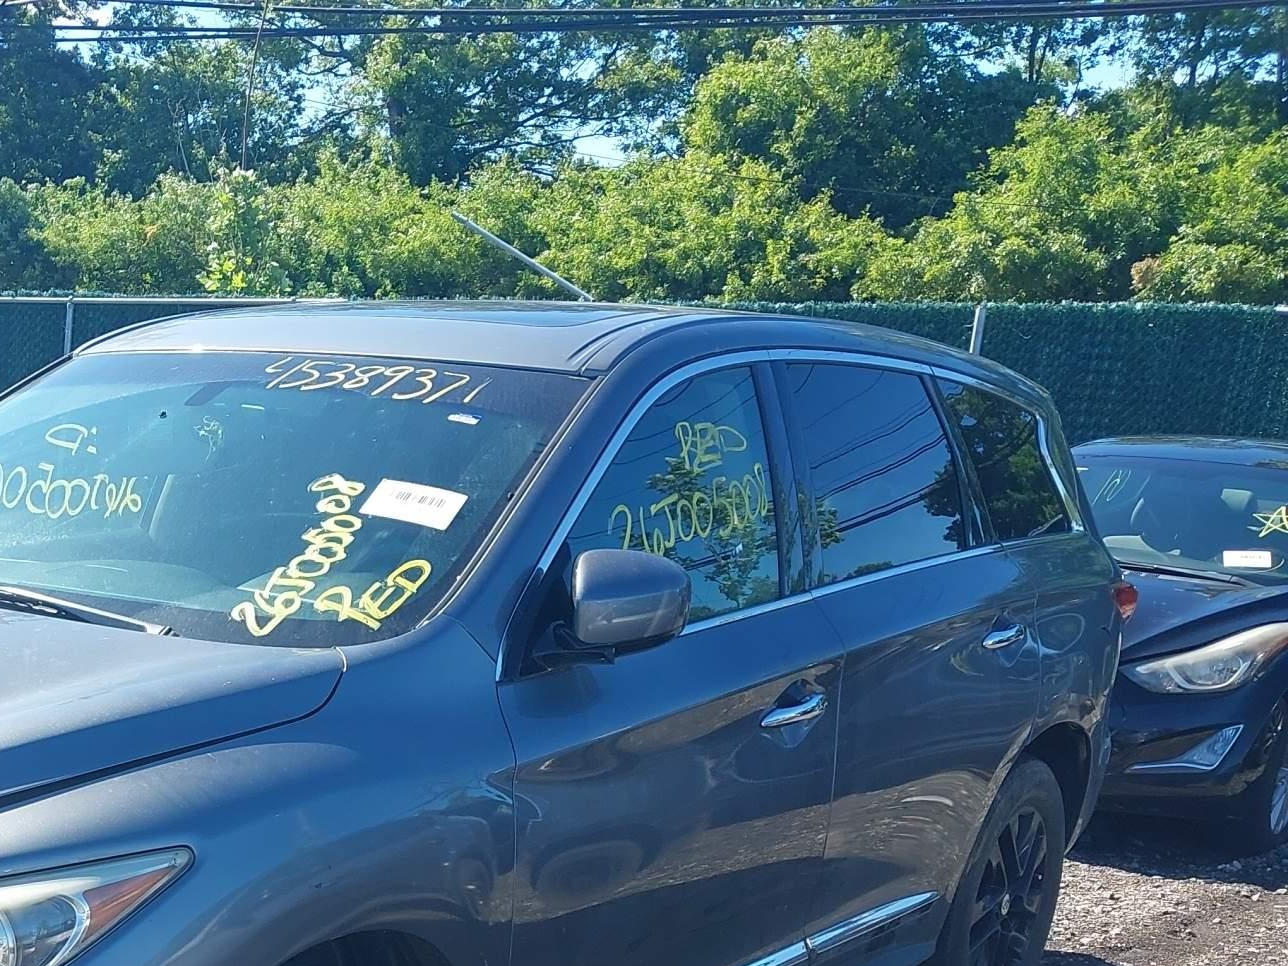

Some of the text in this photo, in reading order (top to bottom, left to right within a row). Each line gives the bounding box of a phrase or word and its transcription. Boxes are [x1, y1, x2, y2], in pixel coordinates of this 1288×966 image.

[264, 356, 493, 404] 45389371
[675, 421, 748, 474] RED
[313, 558, 432, 632] RED
